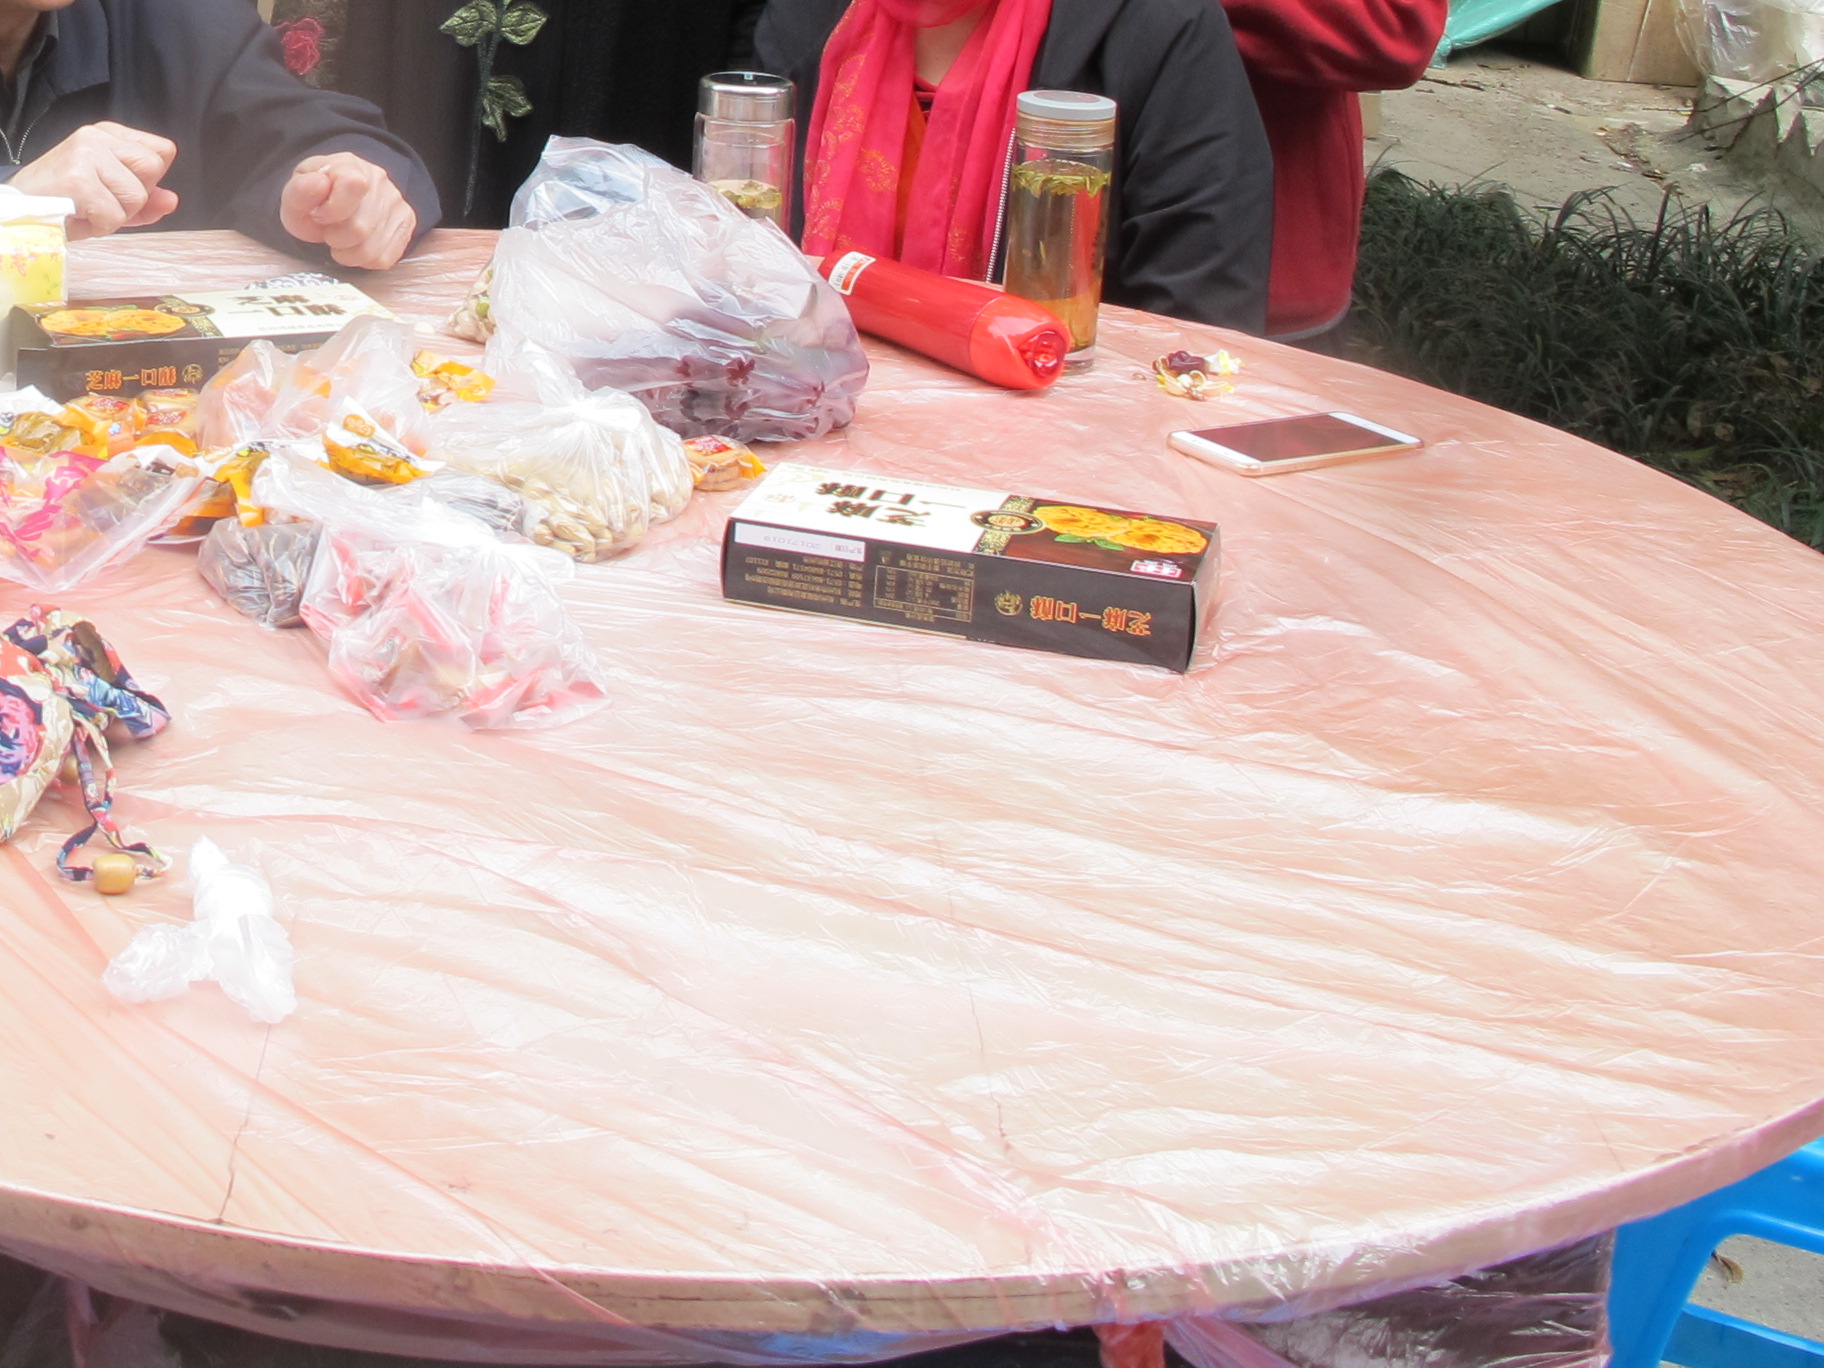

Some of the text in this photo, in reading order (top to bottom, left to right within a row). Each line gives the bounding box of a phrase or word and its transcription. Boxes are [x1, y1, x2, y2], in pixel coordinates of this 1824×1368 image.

[226, 294, 310, 306] 芝麻
[227, 303, 347, 316] 一口酥
[85, 365, 177, 390] 芝麻一口酥
[814, 482, 967, 509] 一口酥
[826, 500, 931, 526] 芝麻
[1030, 595, 1152, 636] 芝麻一口酥
